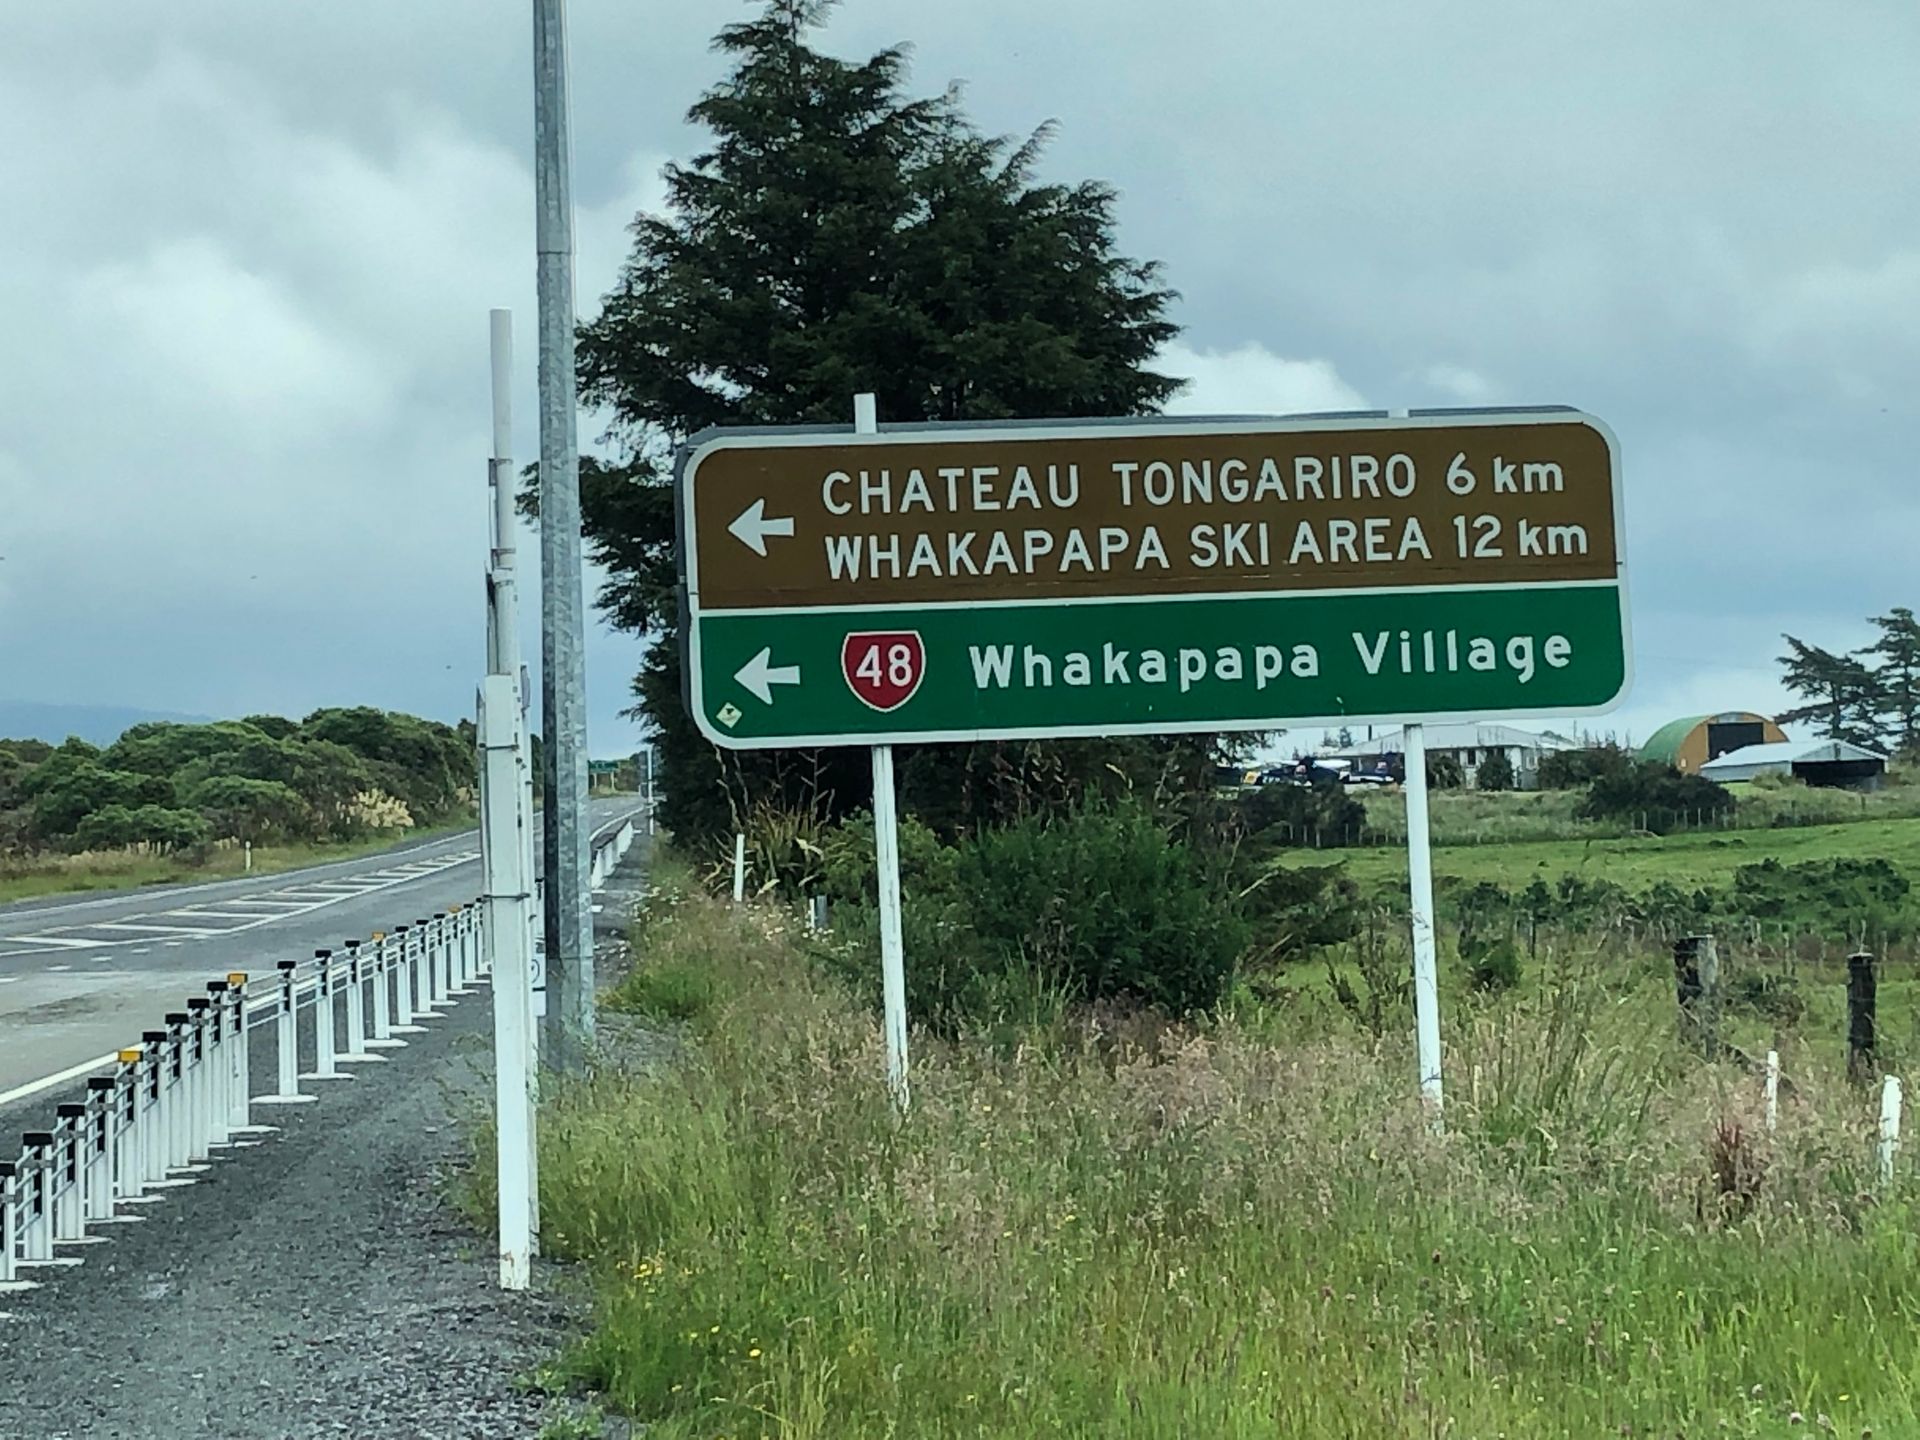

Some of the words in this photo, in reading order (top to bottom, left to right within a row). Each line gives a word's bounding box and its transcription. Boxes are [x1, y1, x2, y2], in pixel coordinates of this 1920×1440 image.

[823, 465, 1079, 515] CHATEAU
[1112, 454, 1416, 506] TONGARIRO
[1446, 452, 1476, 496] 6
[1493, 456, 1564, 494] km
[824, 526, 1170, 582] WHAKAPAPA
[1190, 522, 1269, 567] SKI
[1289, 517, 1432, 564] AREA
[1453, 515, 1503, 559] 12
[1518, 519, 1588, 557] km
[855, 644, 914, 688] 48
[969, 642, 1319, 692] Whakapapa
[1352, 629, 1572, 684] Village
